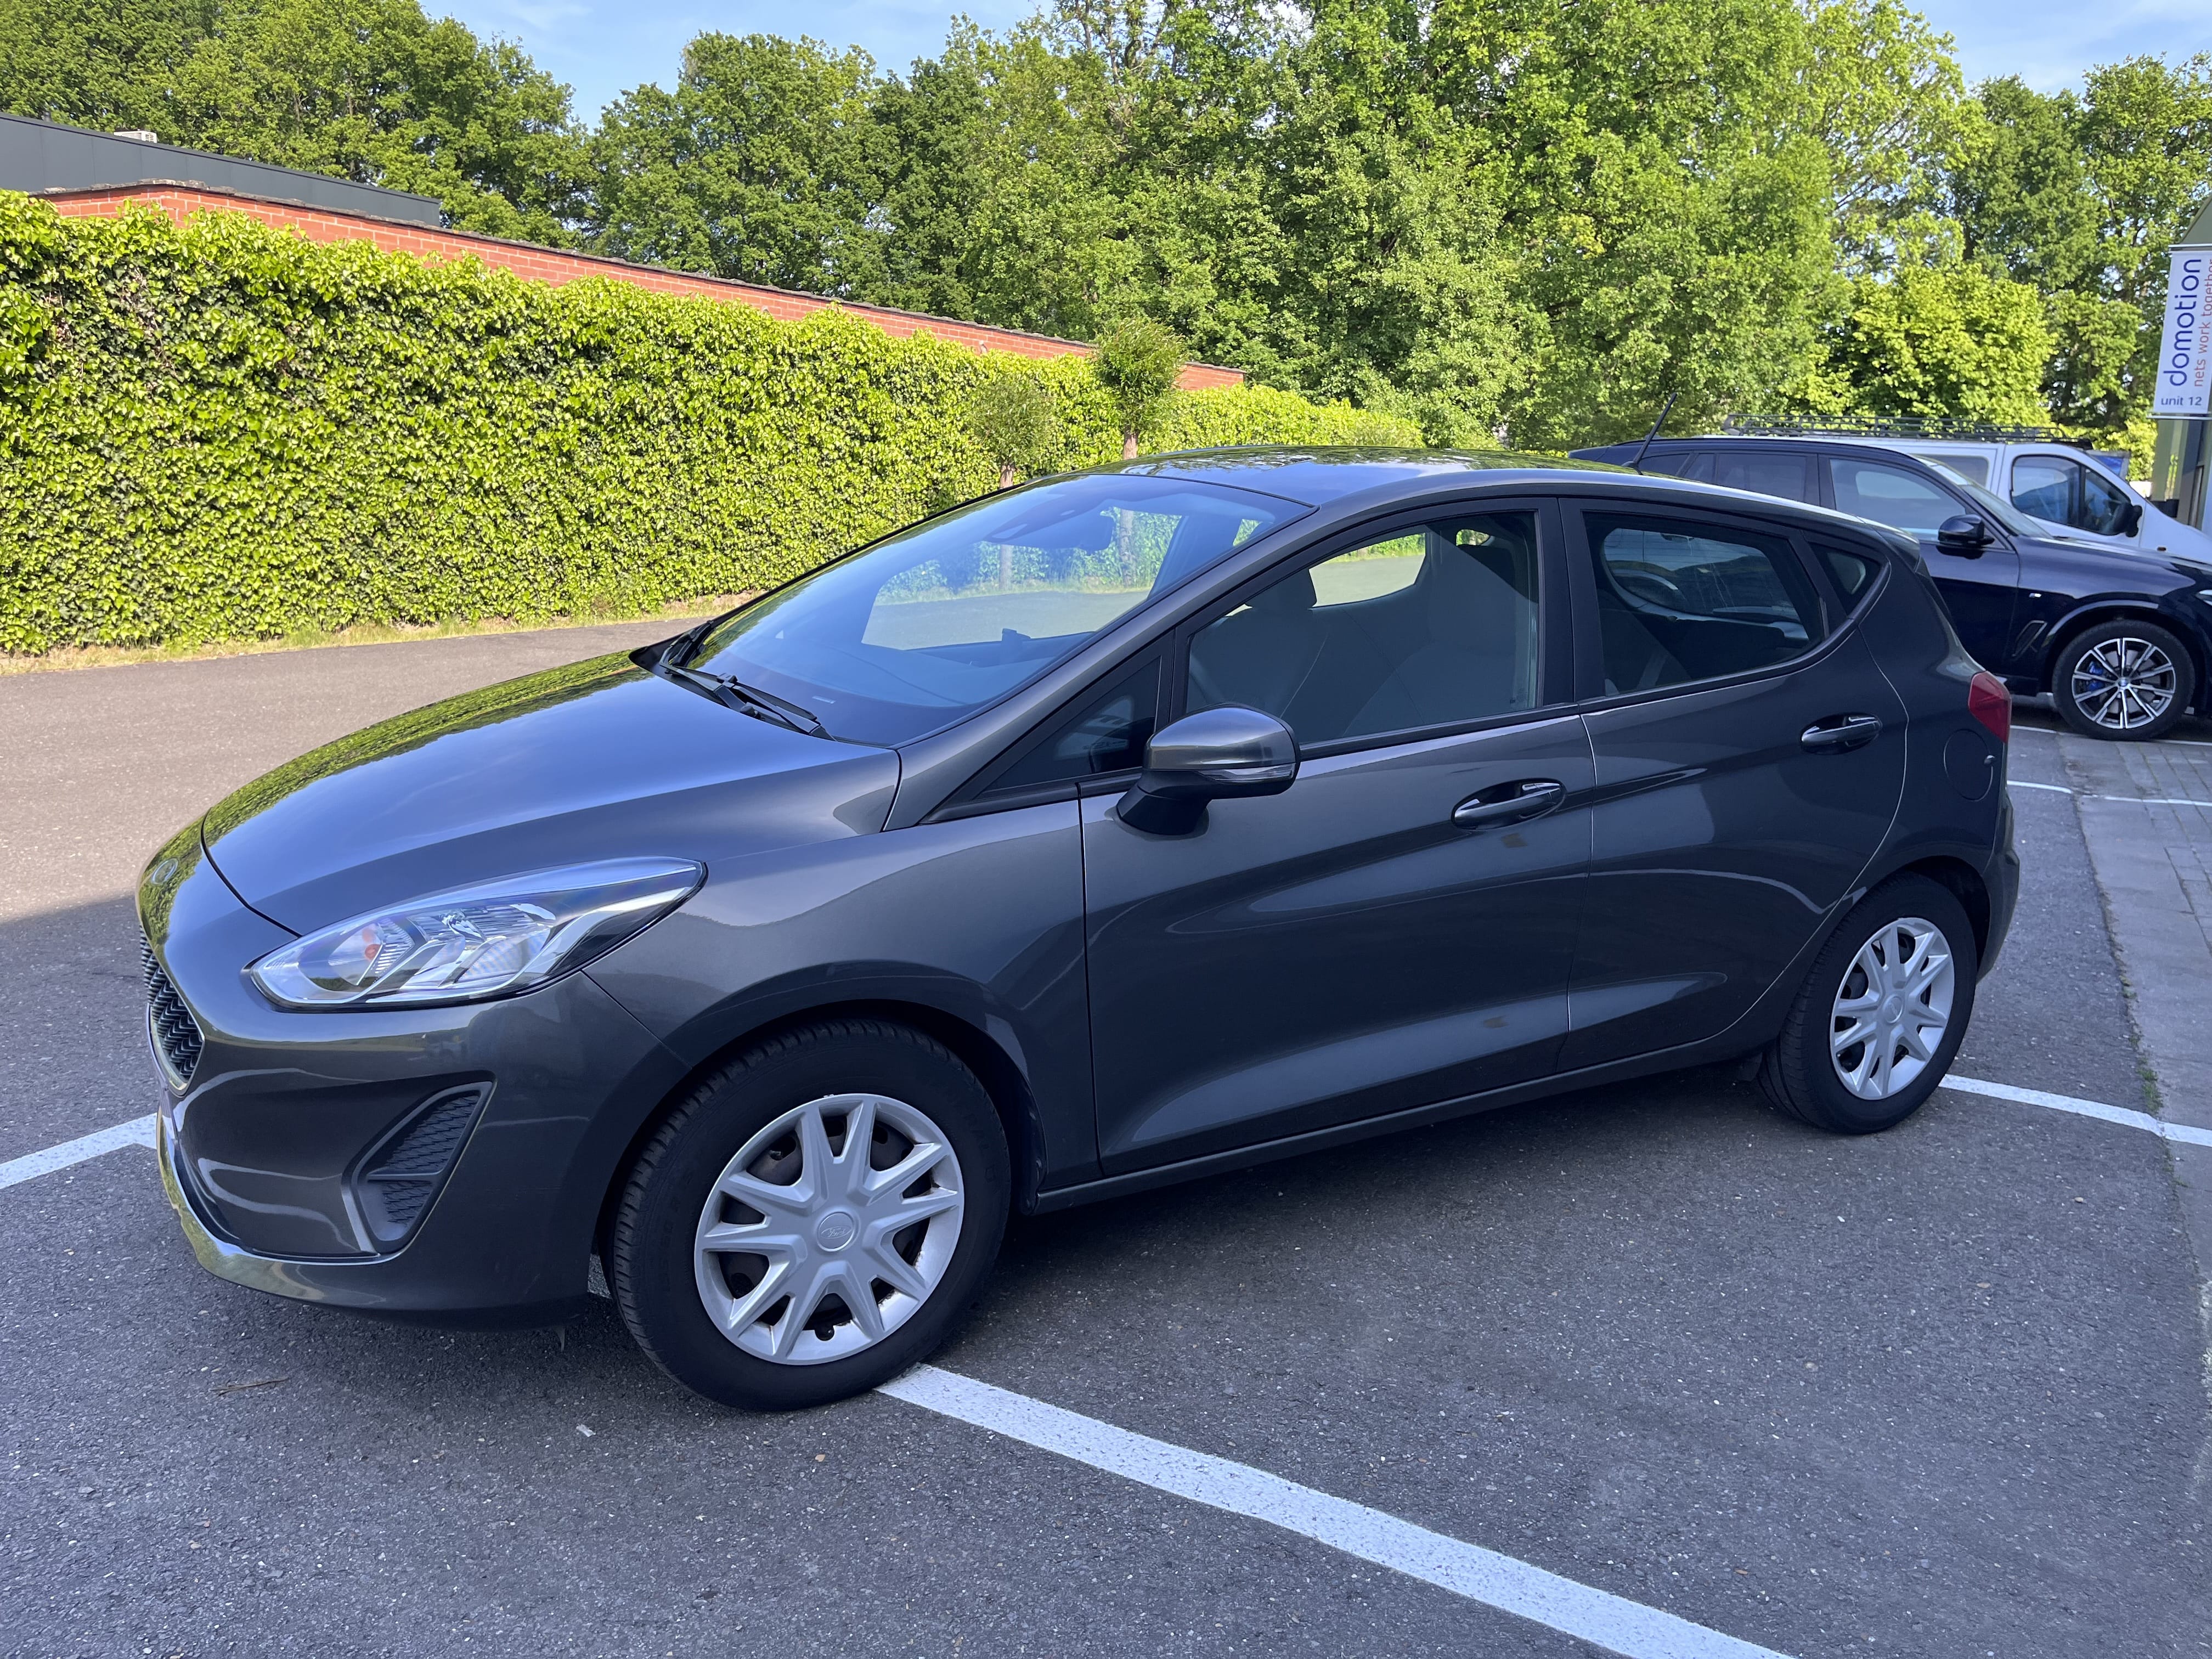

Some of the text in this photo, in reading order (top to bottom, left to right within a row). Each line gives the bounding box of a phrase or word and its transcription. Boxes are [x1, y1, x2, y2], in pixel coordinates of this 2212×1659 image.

[2163, 258, 2202, 386] domotion
[2198, 321, 2211, 353] work
[2194, 359, 2206, 387] nets
[2160, 396, 2202, 406] unit 12
[825, 1227, 847, 1238] Ford
